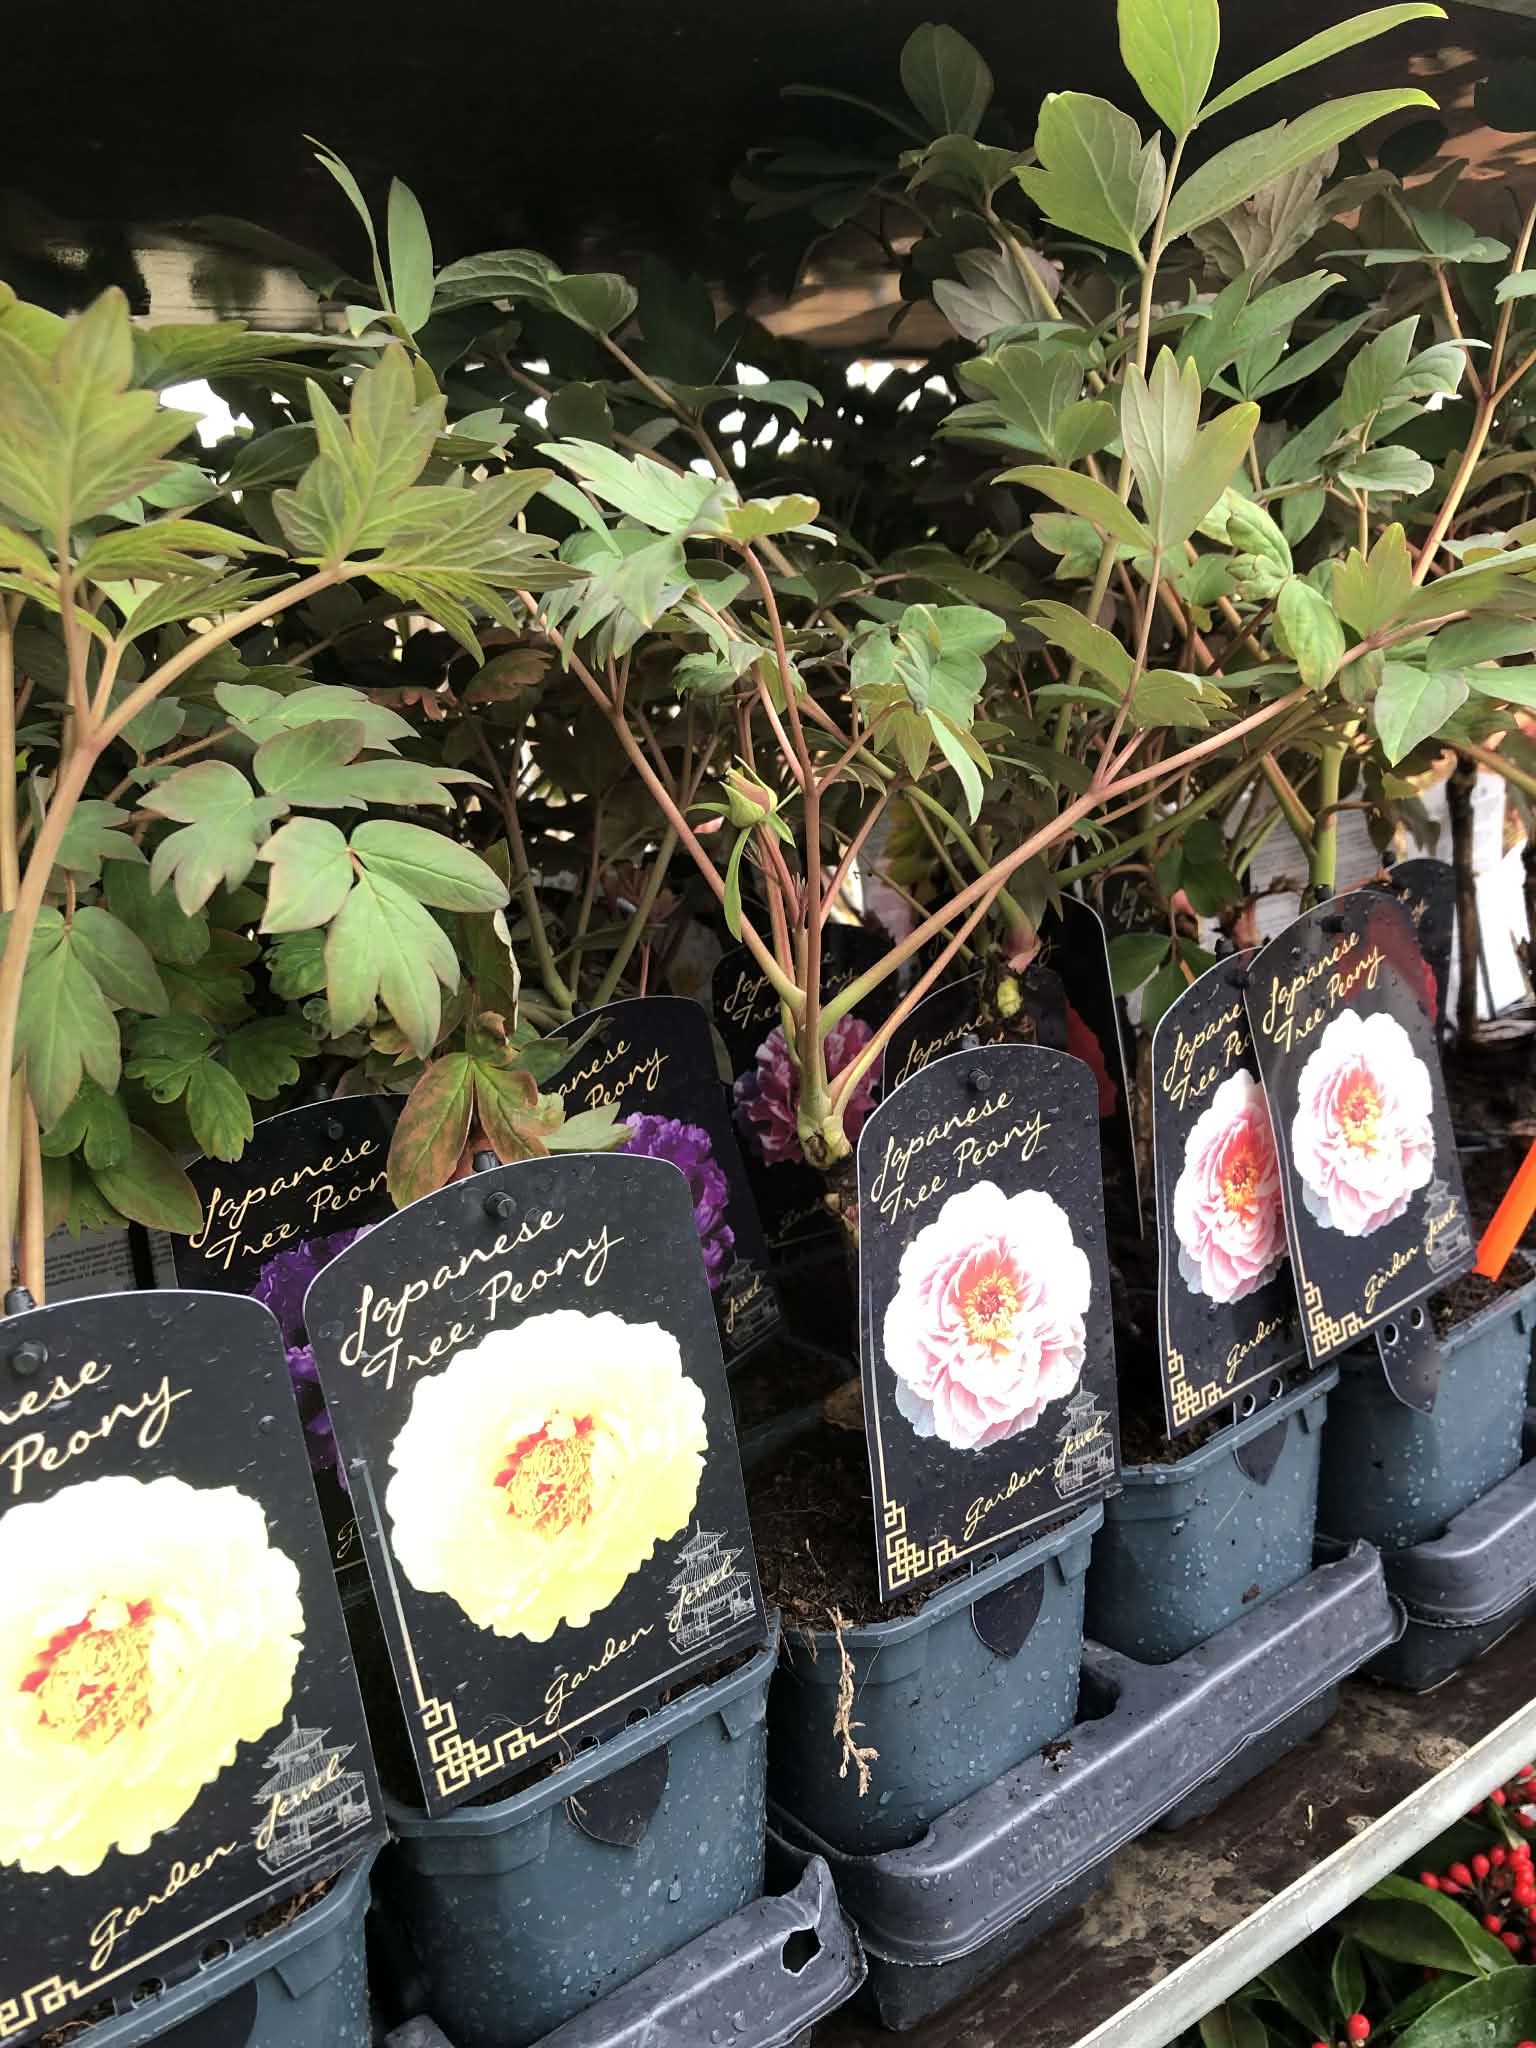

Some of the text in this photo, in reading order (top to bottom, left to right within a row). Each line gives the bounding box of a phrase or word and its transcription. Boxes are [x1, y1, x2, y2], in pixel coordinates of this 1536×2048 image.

[1262, 931, 1360, 1035] Japanese
[1273, 946, 1387, 1054] Tree Peony
[584, 1047, 669, 1110] Peony
[1163, 1002, 1243, 1092] Japane
[1170, 1065, 1219, 1112] Tree
[189, 1139, 380, 1249] Japanese
[870, 1092, 1015, 1202] Japanese
[880, 1175, 948, 1225] Tree
[952, 1111, 1051, 1178] Peony
[204, 1222, 300, 1270] Tree
[306, 1171, 388, 1224] Peon
[1364, 1199, 1458, 1314] Garden Jewel
[340, 1208, 564, 1366] Japanese
[361, 1222, 625, 1389] Tree Peony
[725, 1274, 763, 1334] Jewel
[1225, 1315, 1284, 1384] Garden
[0, 1375, 193, 1495] Peony
[963, 1415, 1105, 1542] Garden Jewel
[543, 1553, 738, 1726] Garden Jewel
[88, 1753, 347, 1972] Garden Jewel
